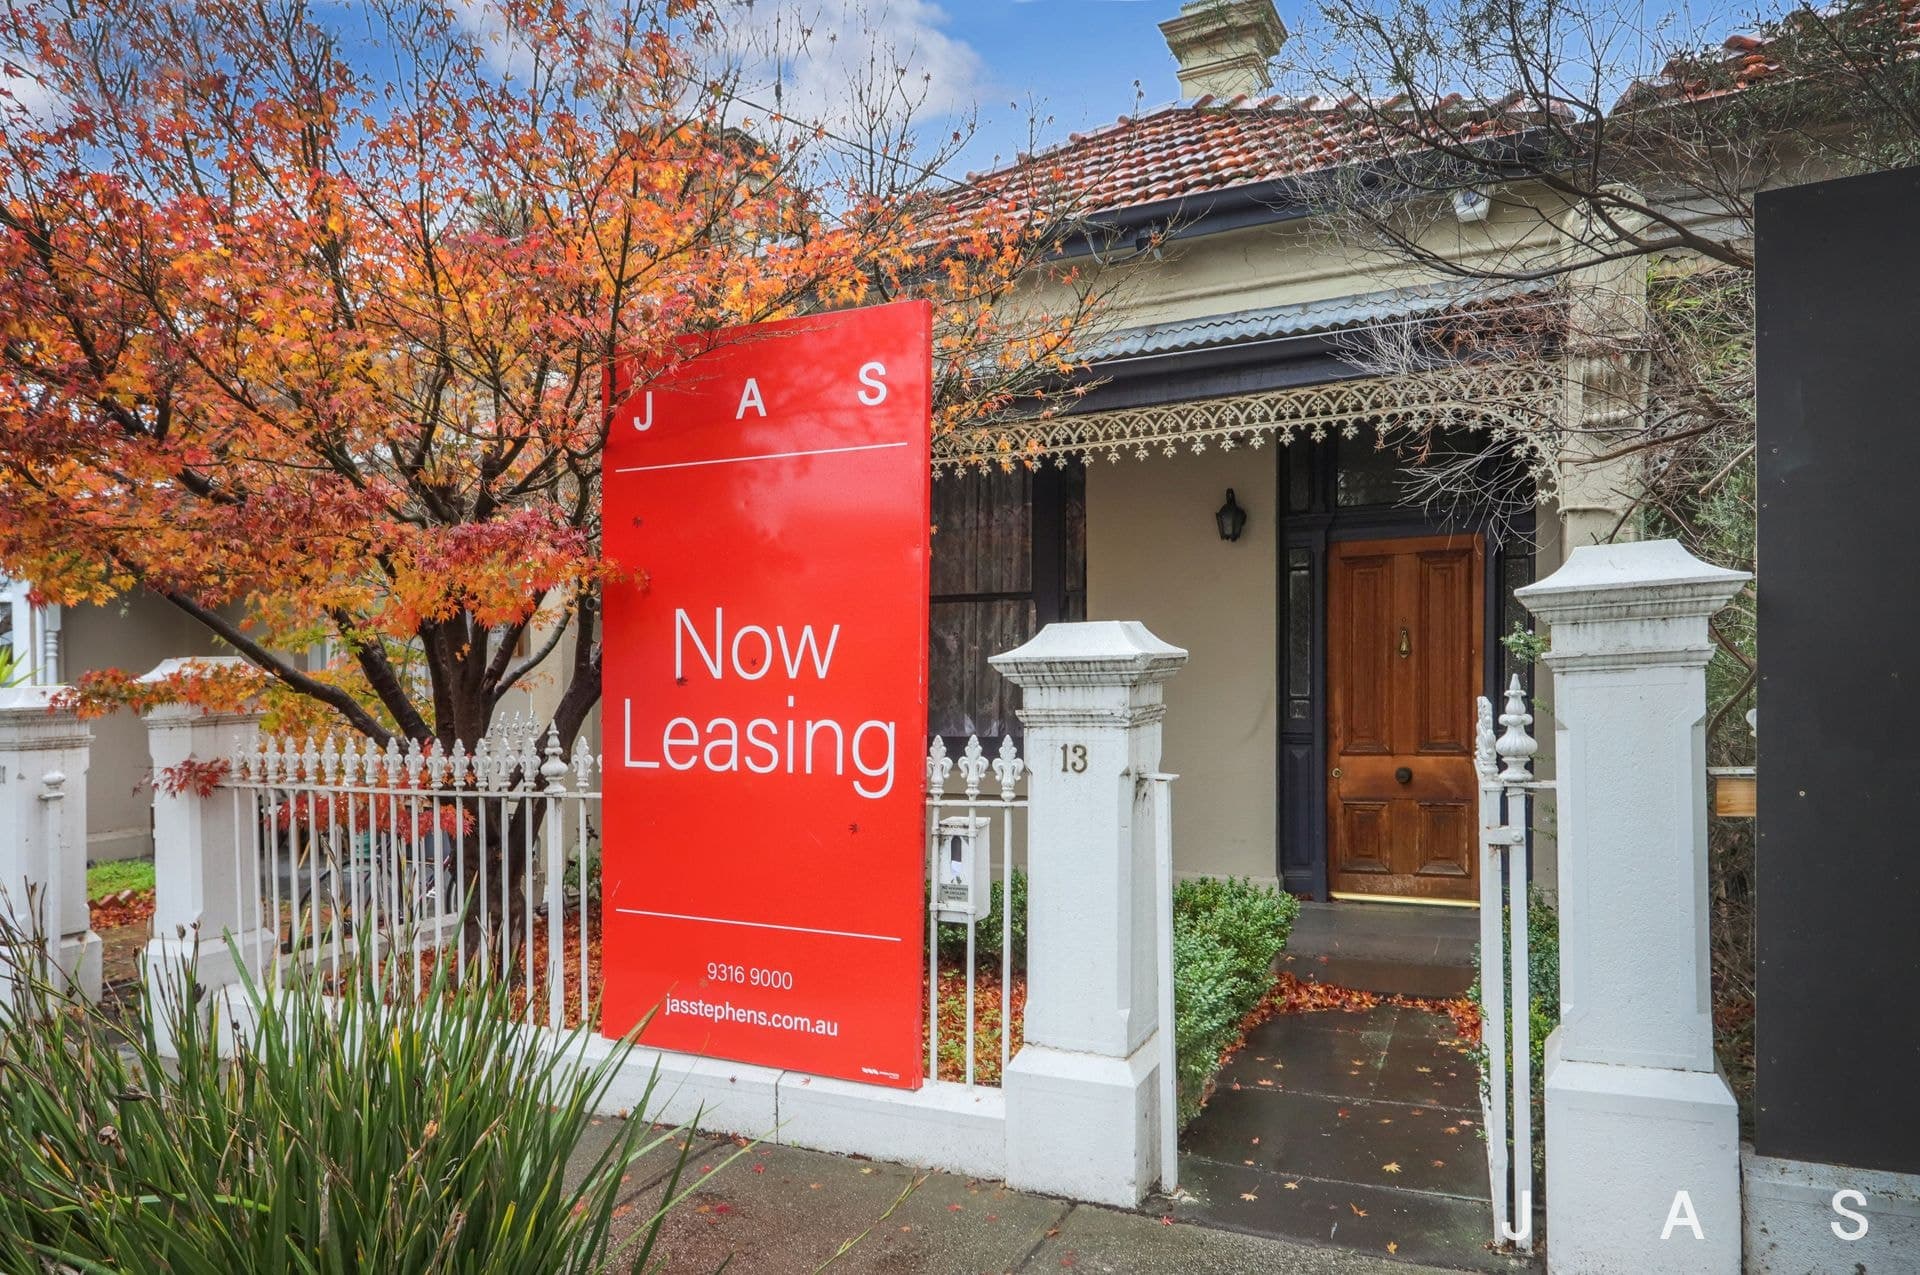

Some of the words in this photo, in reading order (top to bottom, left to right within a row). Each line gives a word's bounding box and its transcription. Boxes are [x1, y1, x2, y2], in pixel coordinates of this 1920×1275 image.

[633, 391, 653, 432] J
[736, 378, 767, 419] A
[857, 361, 888, 406] S
[675, 607, 841, 681] Now
[624, 695, 896, 799] Leasing
[1060, 743, 1088, 774] 13
[707, 962, 745, 984] 9316
[749, 967, 793, 990] 9000
[665, 993, 839, 1037] jasstephens.com.au
